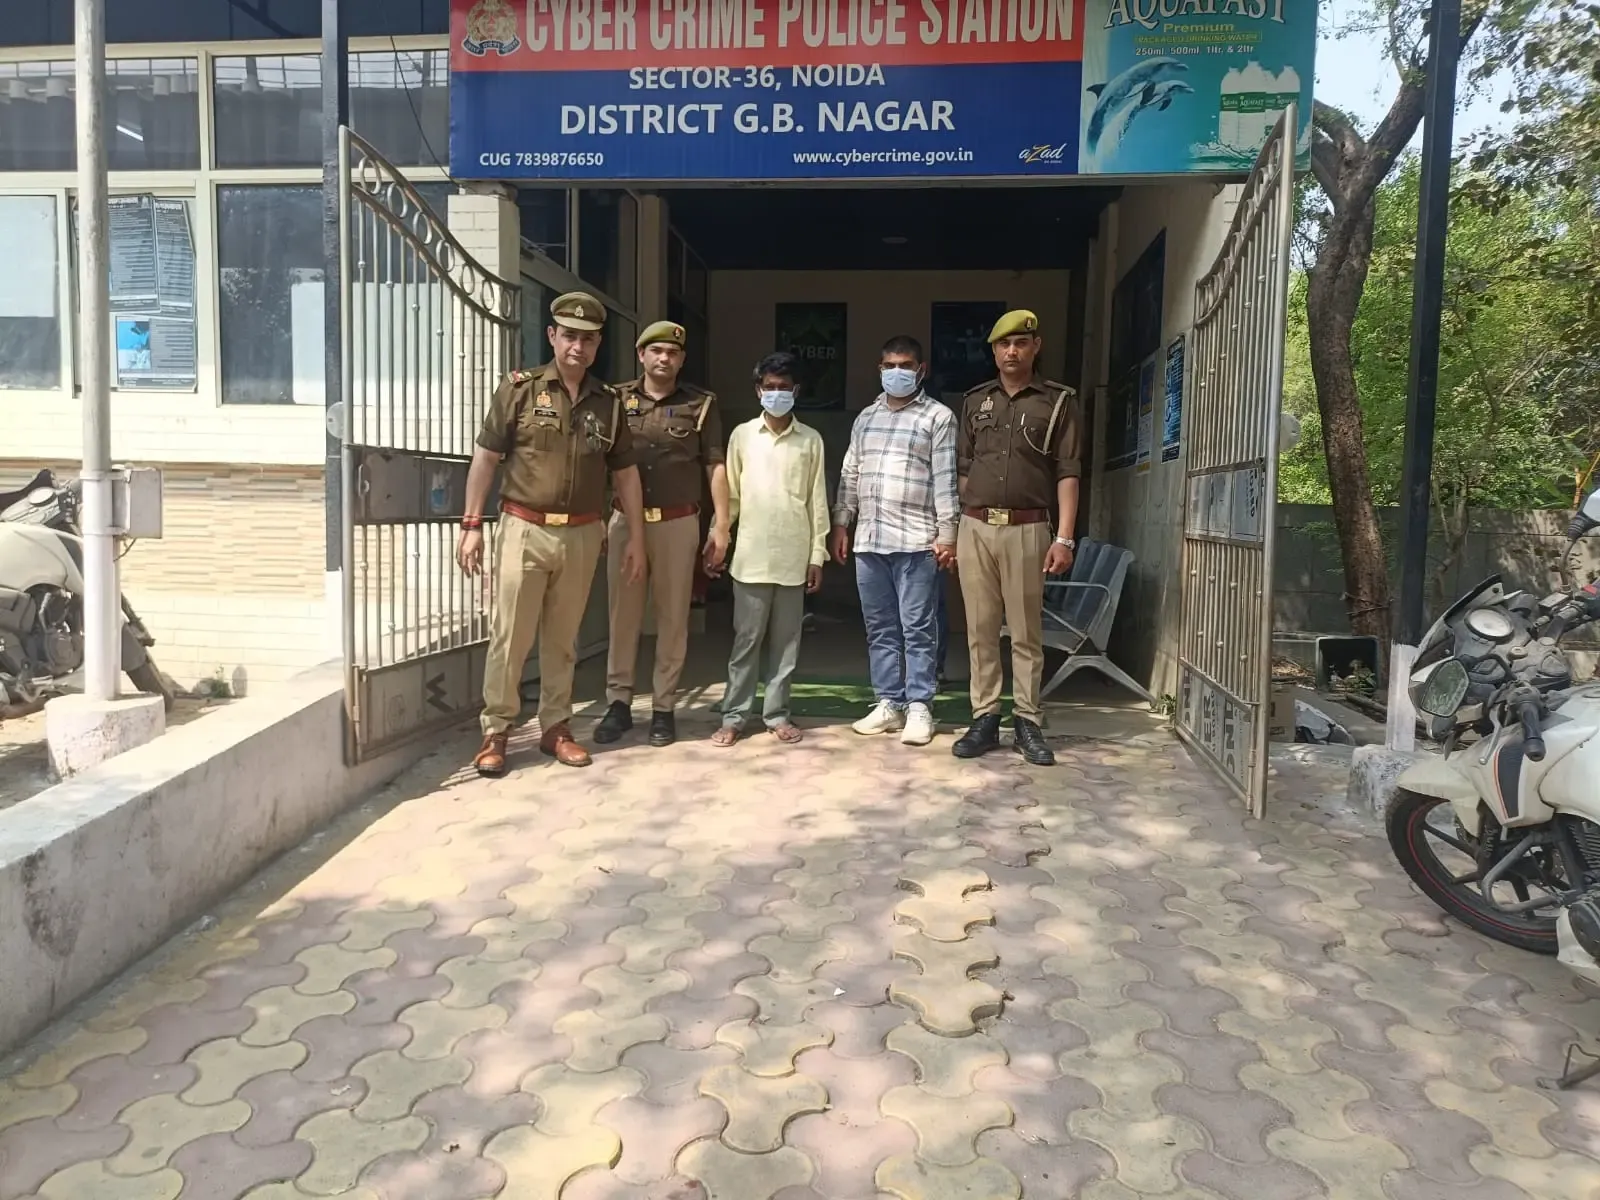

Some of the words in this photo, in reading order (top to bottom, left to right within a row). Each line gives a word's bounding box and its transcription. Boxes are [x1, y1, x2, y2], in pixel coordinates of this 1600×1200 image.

[525, 0, 637, 52] CYBER
[650, 0, 765, 50] CRIME
[778, 0, 906, 47] POLICE
[919, 0, 1073, 45] STATION
[1163, 23, 1234, 33] Premium
[1137, 35, 1184, 44] PACKAGED
[1188, 34, 1226, 43] DRINKING
[1227, 45, 1234, 53] &
[628, 64, 782, 91] SECTOR-36,
[791, 63, 886, 87] NOIDA
[560, 103, 723, 135] DISTRICT
[733, 103, 804, 134] G.B.
[817, 101, 955, 133] NAGAR
[479, 152, 511, 166] CUG
[515, 152, 604, 166] 7839876650
[793, 147, 974, 167] www.cybercrime.gov.in
